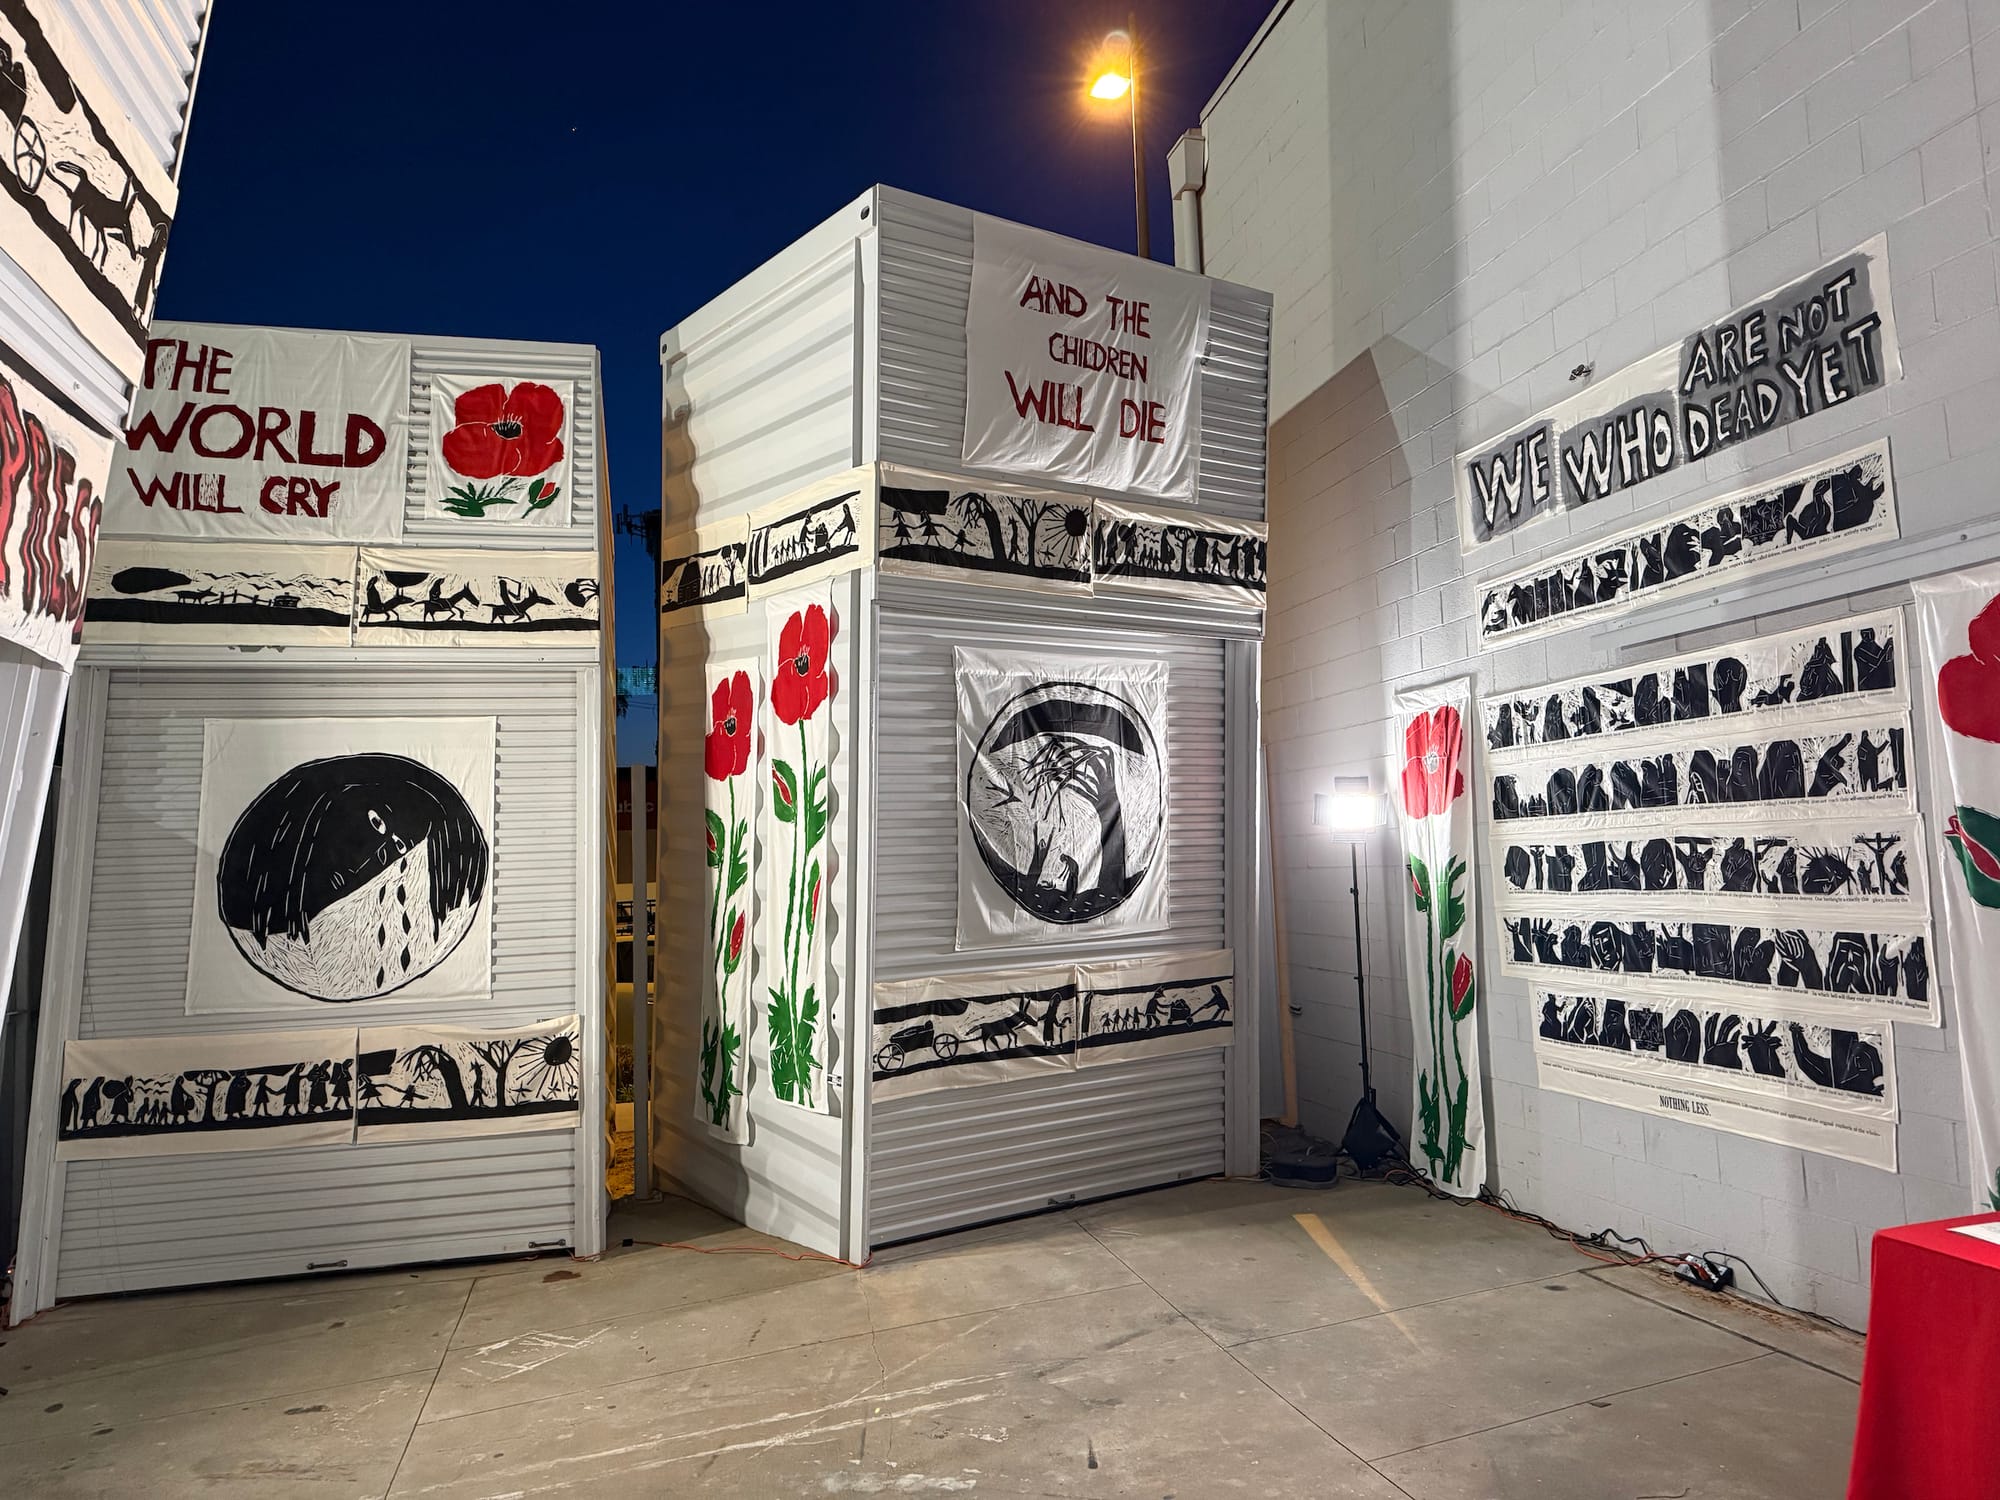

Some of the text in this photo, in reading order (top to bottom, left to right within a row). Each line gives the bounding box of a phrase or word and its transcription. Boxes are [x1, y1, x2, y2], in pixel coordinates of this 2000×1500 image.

[1020, 276, 1150, 338] AND THE
[1680, 267, 1857, 396] ARE NOT
[144, 339, 234, 395] THE
[1048, 332, 1148, 384] CHILDREN
[1683, 313, 1881, 459] DEAD YET
[124, 402, 387, 468] WORLD
[1005, 370, 1166, 444] WILL DIE
[127, 468, 342, 519] WILL CRY
[1472, 404, 1676, 532] WE WHO
[1659, 1095, 1690, 1113] NOTHING
[1692, 1101, 1711, 1117] LESS.
